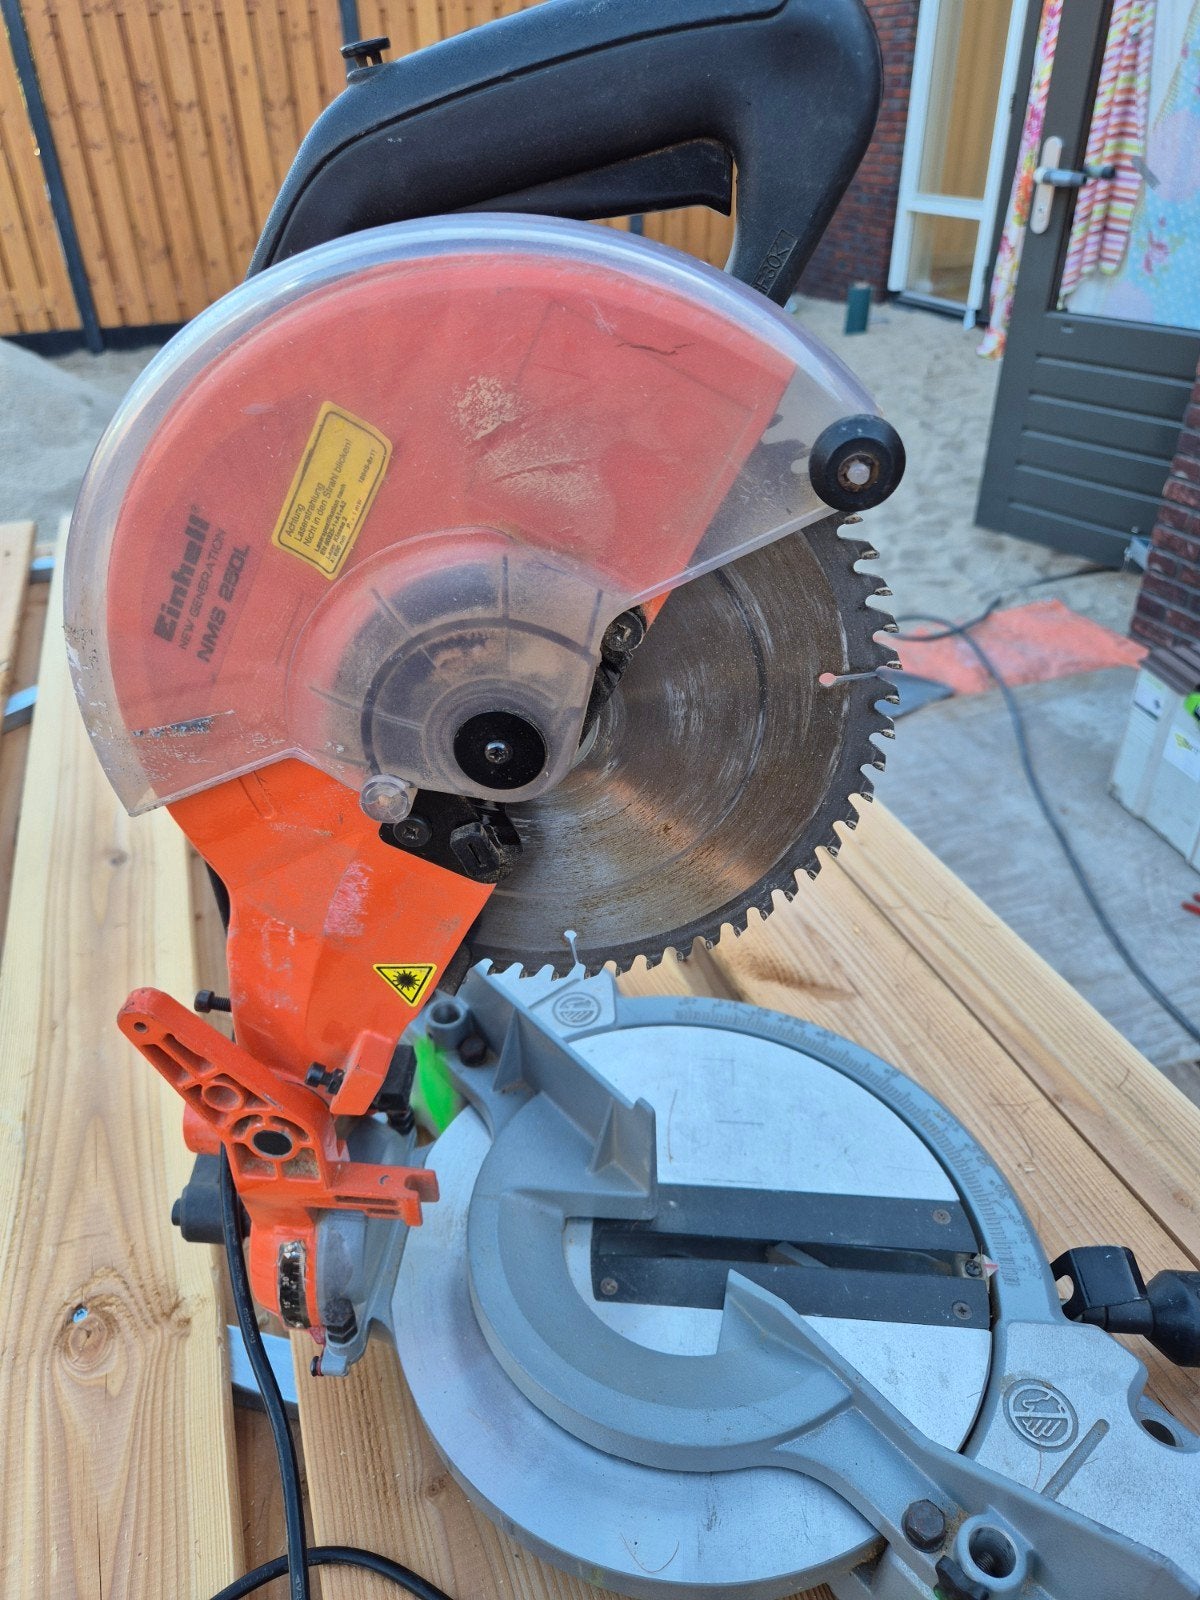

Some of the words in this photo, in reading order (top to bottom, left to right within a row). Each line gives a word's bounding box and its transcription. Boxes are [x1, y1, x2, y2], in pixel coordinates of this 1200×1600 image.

[334, 438, 353, 473] blicken!
[322, 471, 339, 498] Strahl
[284, 502, 305, 537] Achtung
[294, 481, 325, 541] Laserstrahlung
[312, 516, 321, 525] in
[316, 498, 328, 515] den
[303, 525, 317, 546] Nicht
[153, 514, 211, 642] Einhell
[178, 619, 195, 650] NEW
[189, 528, 227, 617] GENERATION
